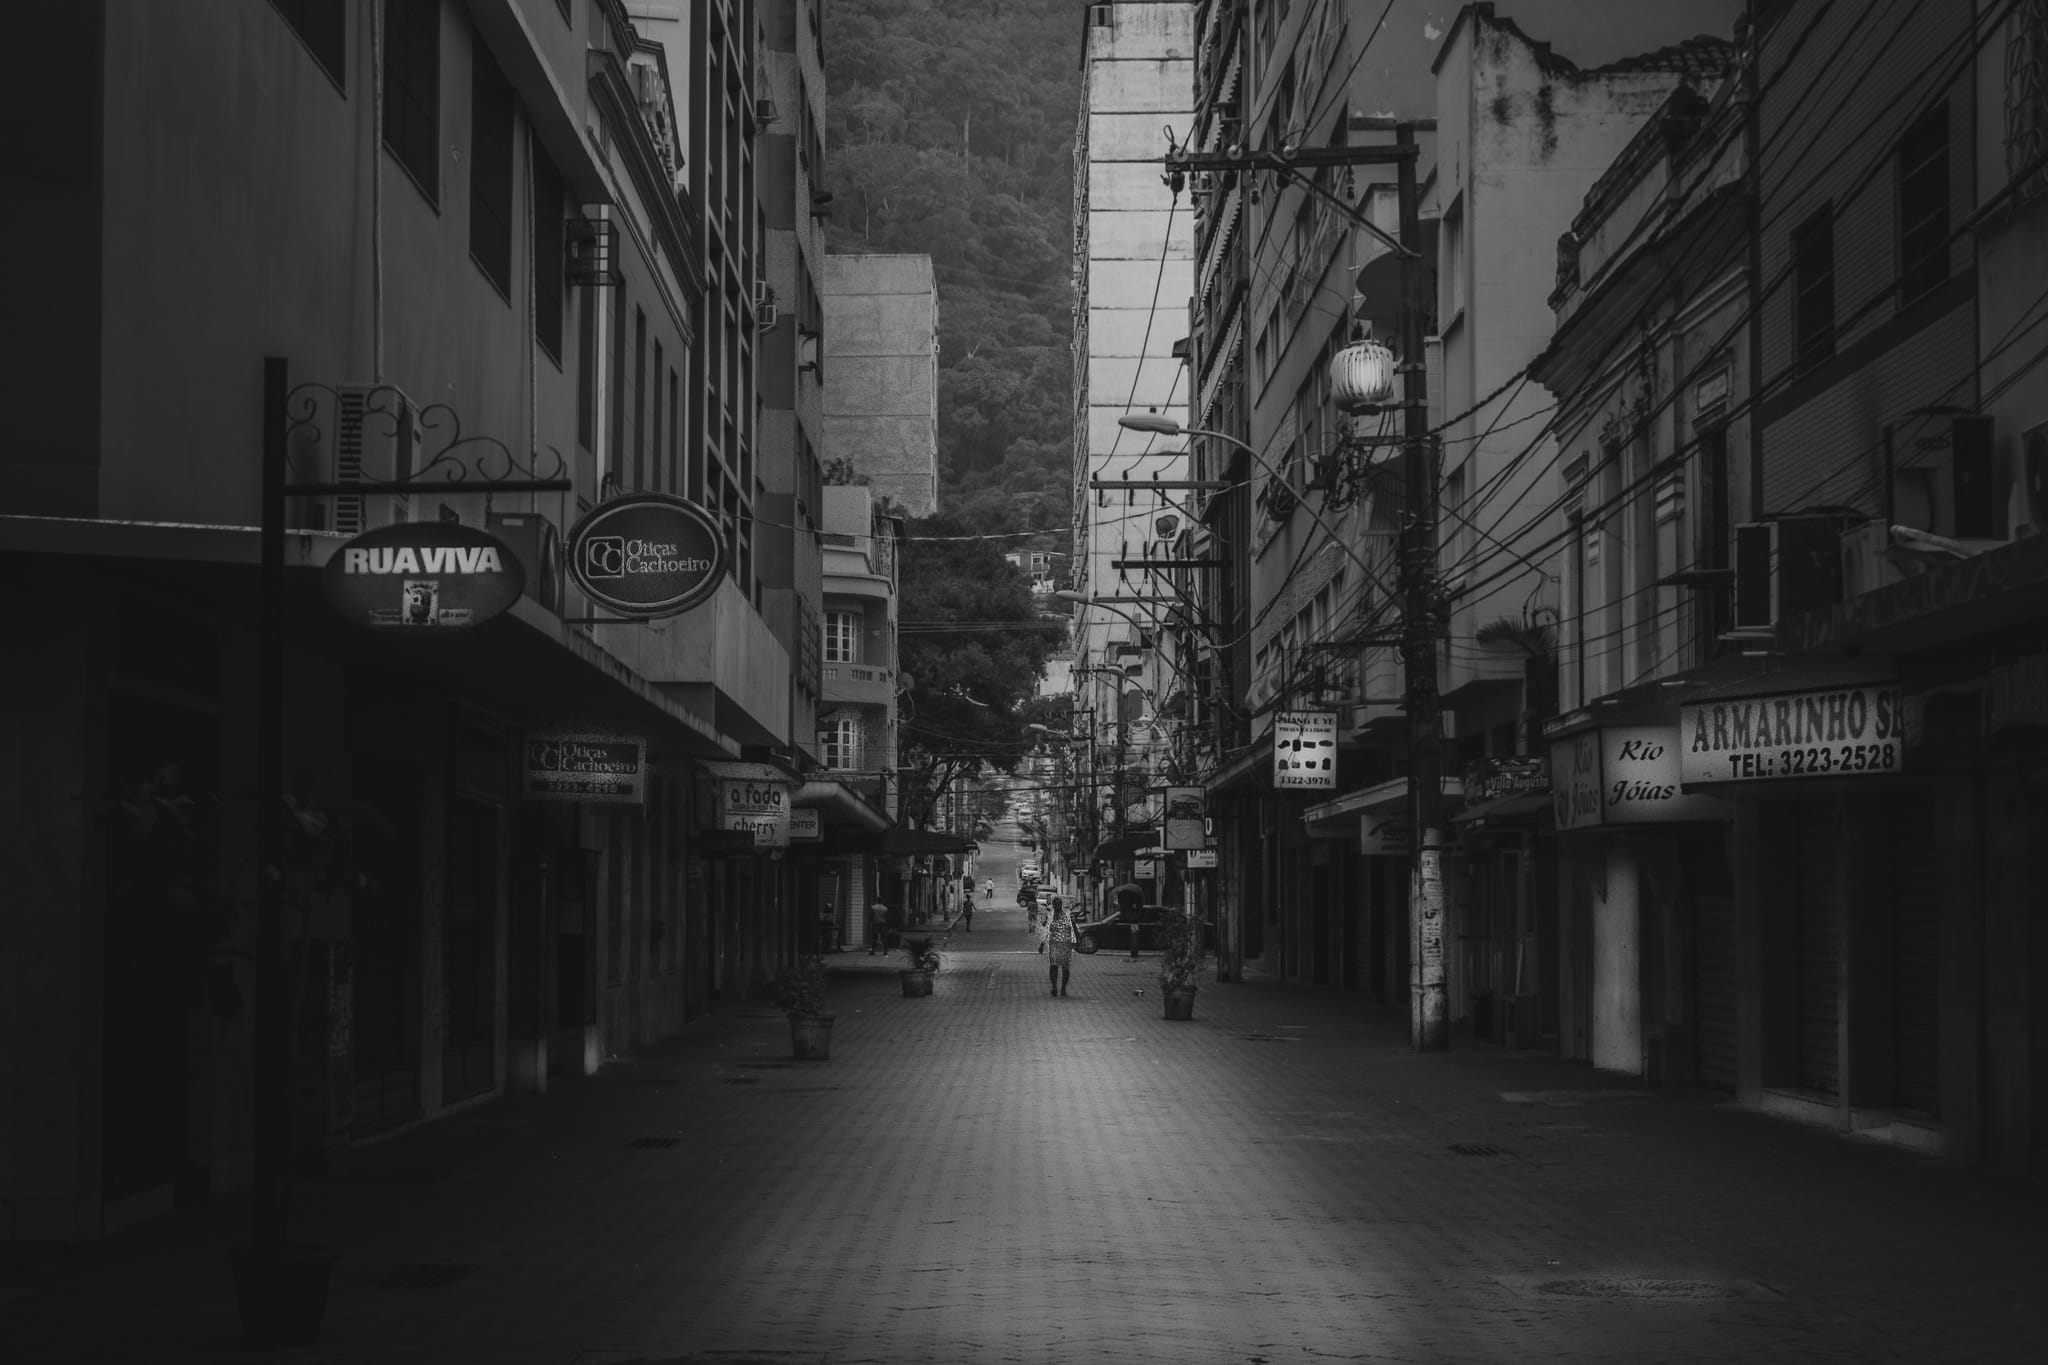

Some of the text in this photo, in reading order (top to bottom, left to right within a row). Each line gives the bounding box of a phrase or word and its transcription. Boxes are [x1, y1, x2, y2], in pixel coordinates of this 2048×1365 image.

[344, 546, 503, 574] RUA VIVA
[626, 554, 711, 574] Cachoeiro
[1692, 690, 1867, 753] ARMARINHO
[1619, 740, 1664, 761] Rio
[1729, 743, 1896, 779] TEL: 3223-2528
[562, 757, 638, 774] Cachoeiro
[731, 788, 741, 803] a
[1608, 780, 1676, 806] Jóias
[734, 817, 777, 840] cherry
